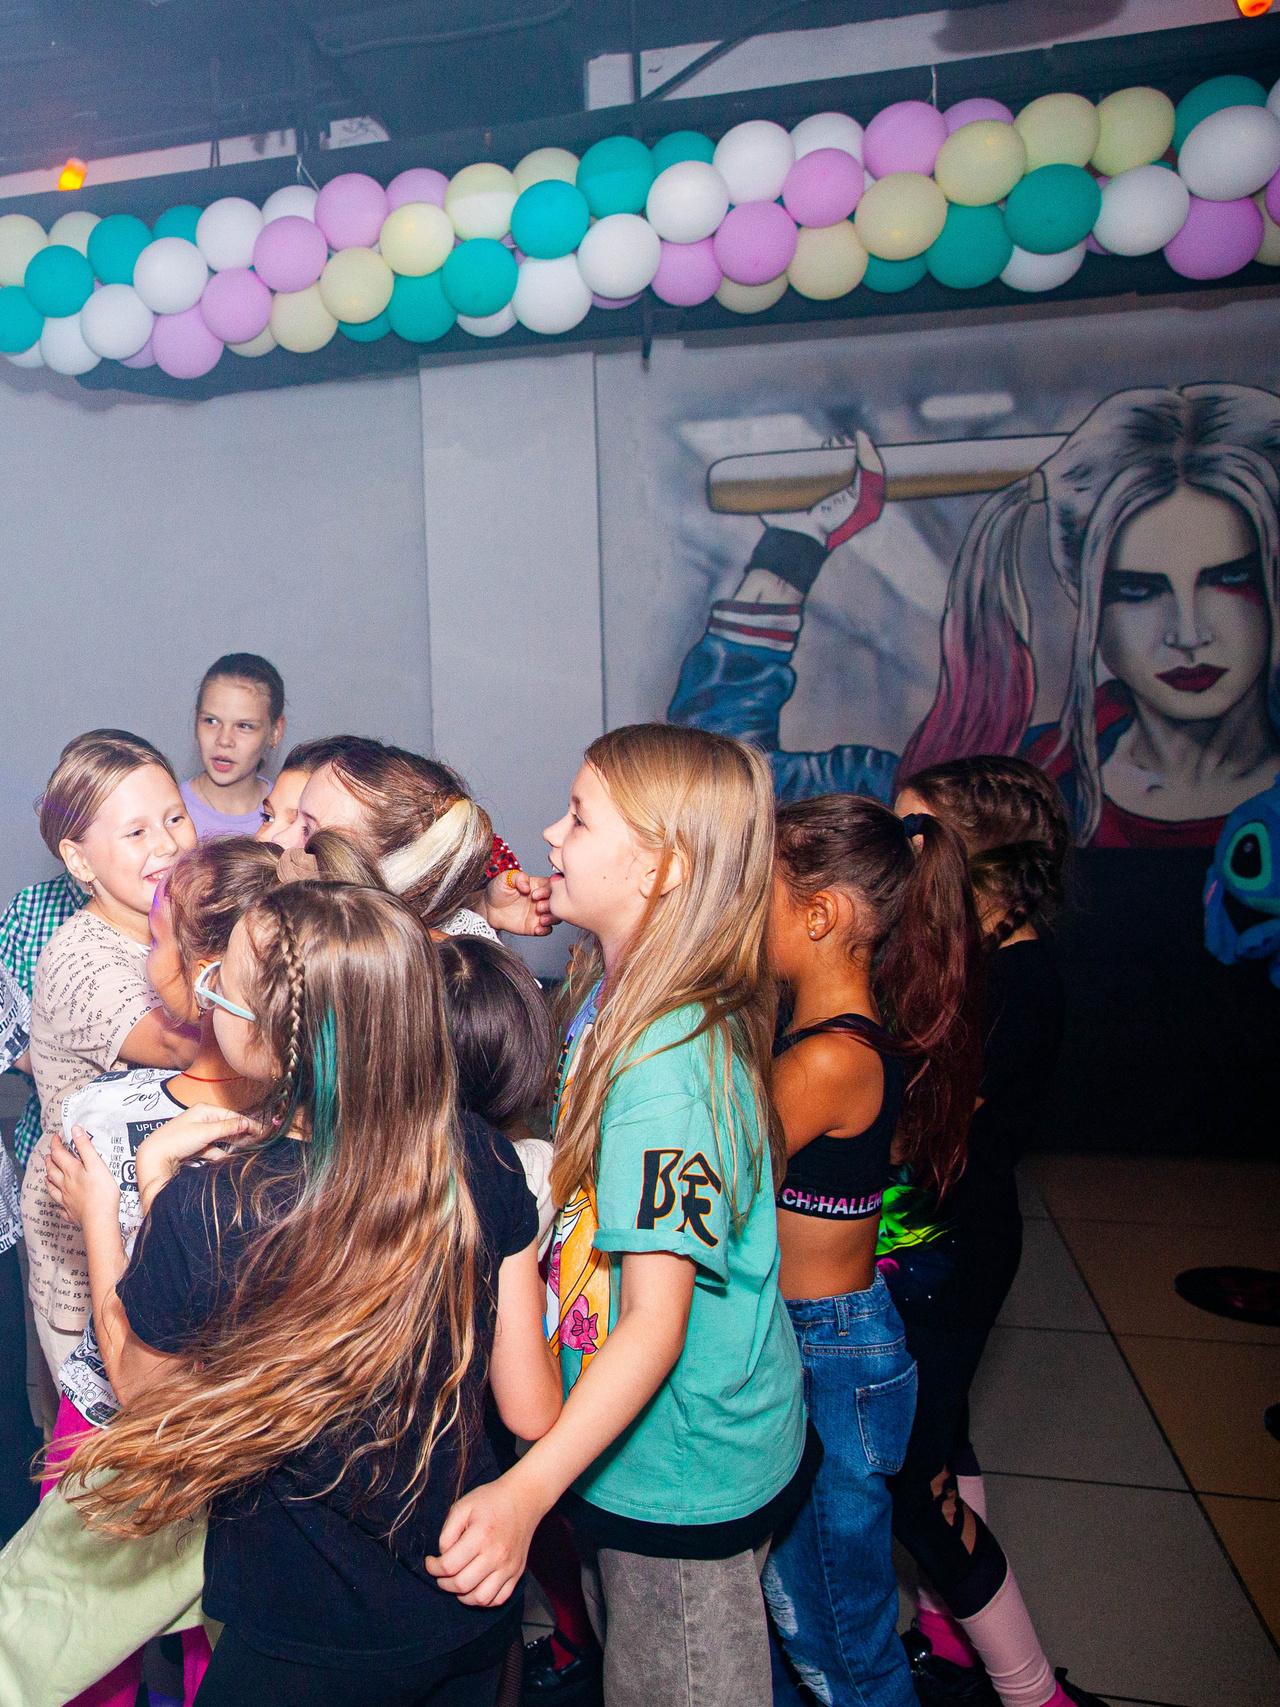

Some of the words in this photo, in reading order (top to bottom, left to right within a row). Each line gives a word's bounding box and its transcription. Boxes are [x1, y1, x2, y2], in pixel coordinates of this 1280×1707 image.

[81, 952, 91, 961] IT
[139, 1005, 153, 1017] DO
[122, 1090, 160, 1111] Joy
[111, 1136, 123, 1145] LIKE
[113, 1145, 124, 1154] FOR
[111, 1154, 122, 1162] LIKE
[109, 1161, 120, 1169] FOR
[111, 1169, 122, 1178] IKE
[63, 1303, 86, 1313] DOING
